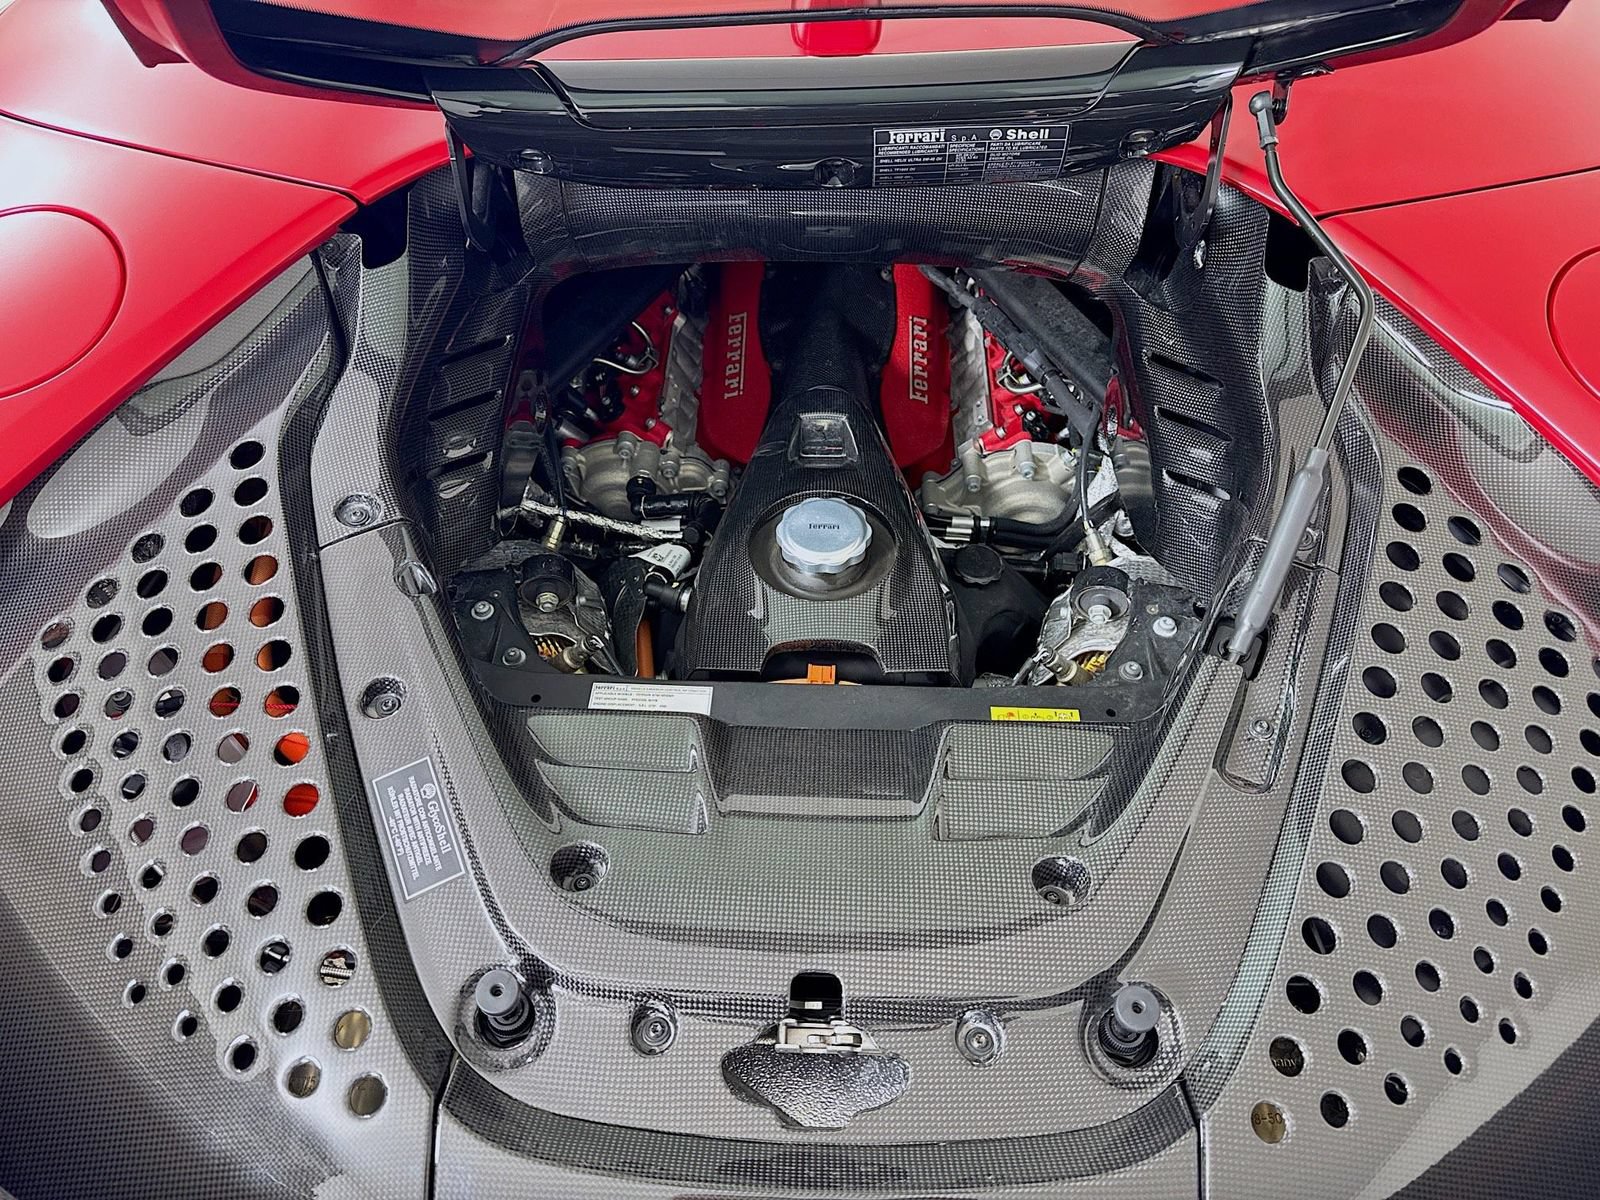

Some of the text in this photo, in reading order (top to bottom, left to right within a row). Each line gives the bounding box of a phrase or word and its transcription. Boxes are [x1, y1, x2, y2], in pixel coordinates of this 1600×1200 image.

[888, 130, 946, 144] Ferrari
[1006, 128, 1049, 140] Shell
[724, 312, 747, 399] Ferrari
[909, 316, 928, 404] Ferrari
[403, 786, 417, 816] RADIATOR
[411, 814, 421, 831] WITH
[428, 801, 452, 854] GlycoShell
